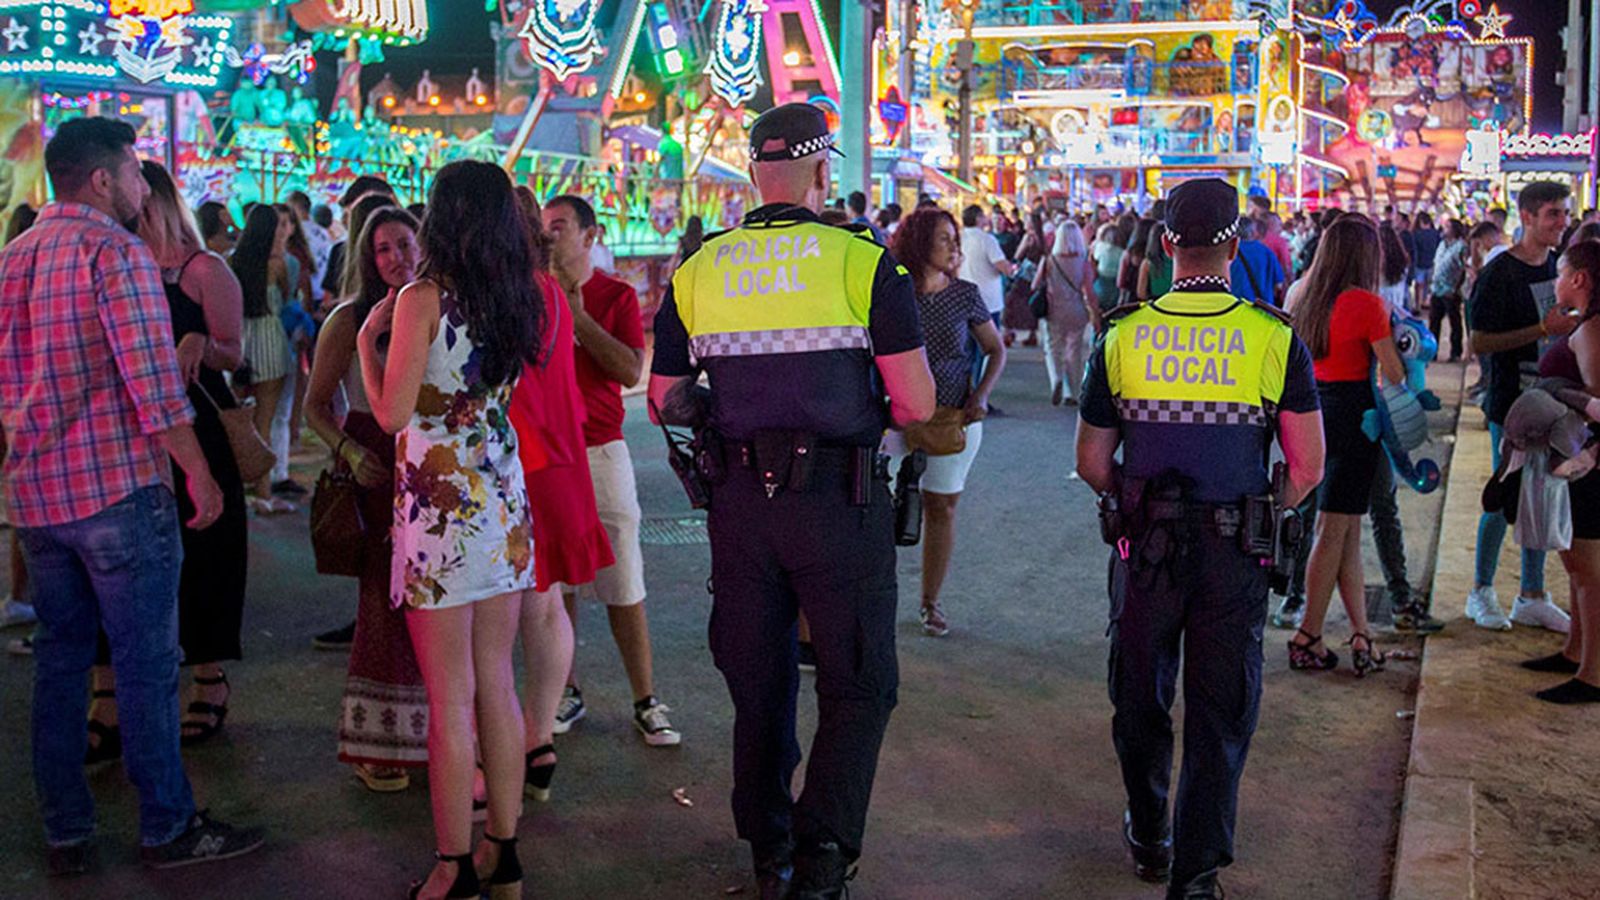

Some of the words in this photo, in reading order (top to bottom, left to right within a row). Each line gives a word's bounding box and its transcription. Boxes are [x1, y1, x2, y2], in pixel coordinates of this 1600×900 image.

[715, 235, 820, 267] POLICIA
[724, 264, 806, 298] LOCAL
[1134, 325, 1246, 355] POLICIA
[1145, 355, 1236, 385] LOCAL
